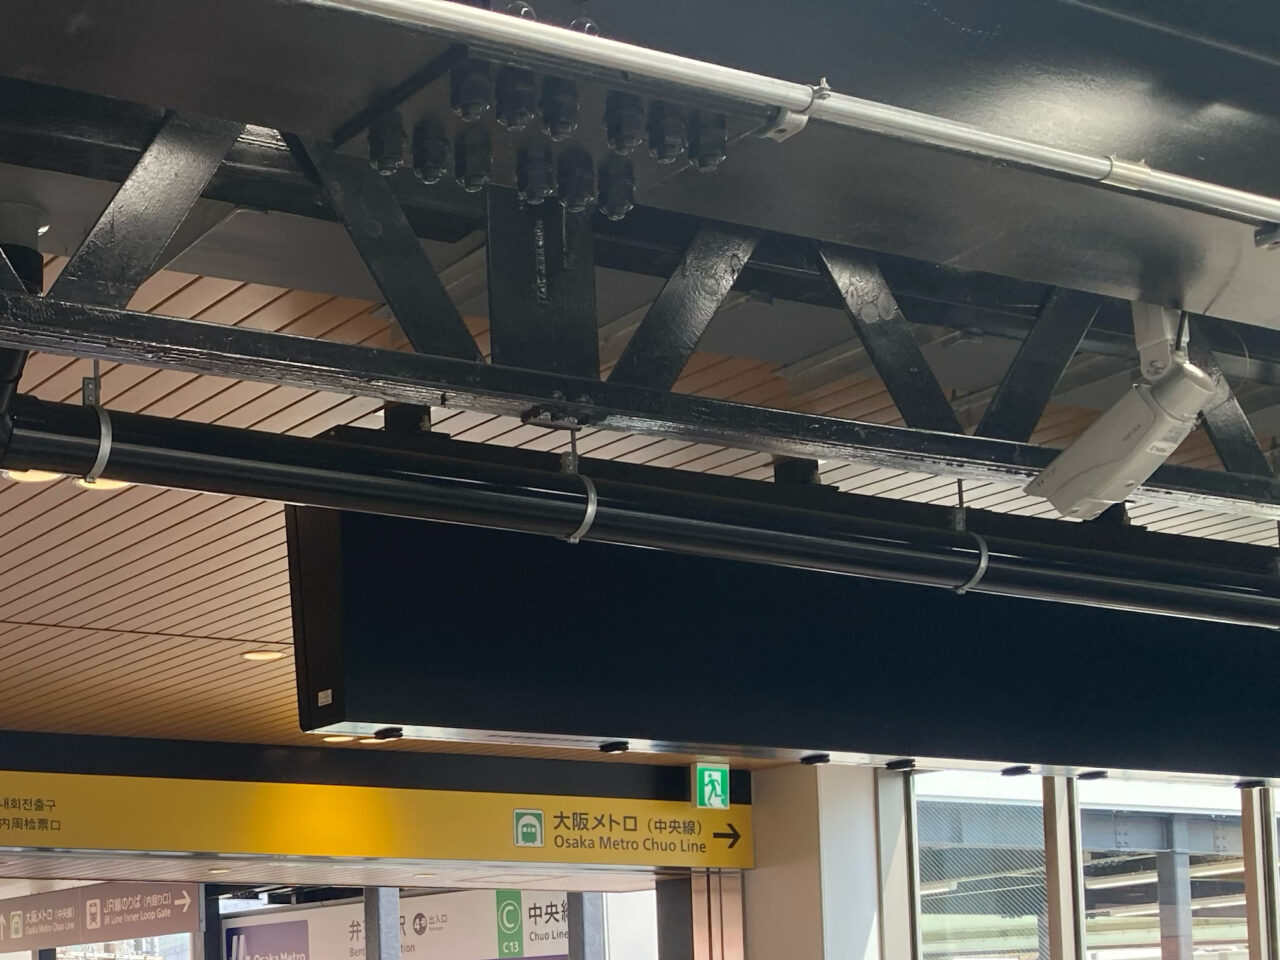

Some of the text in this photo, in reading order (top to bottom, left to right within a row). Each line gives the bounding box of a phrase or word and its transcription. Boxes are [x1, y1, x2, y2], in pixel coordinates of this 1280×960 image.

[554, 835, 706, 853] Osaka Metro Chuo Line
[141, 911, 156, 920] Loop
[157, 908, 171, 918] Gate
[429, 914, 447, 925] 出入口
[529, 931, 550, 942] Chuo
[503, 941, 519, 953] C13
